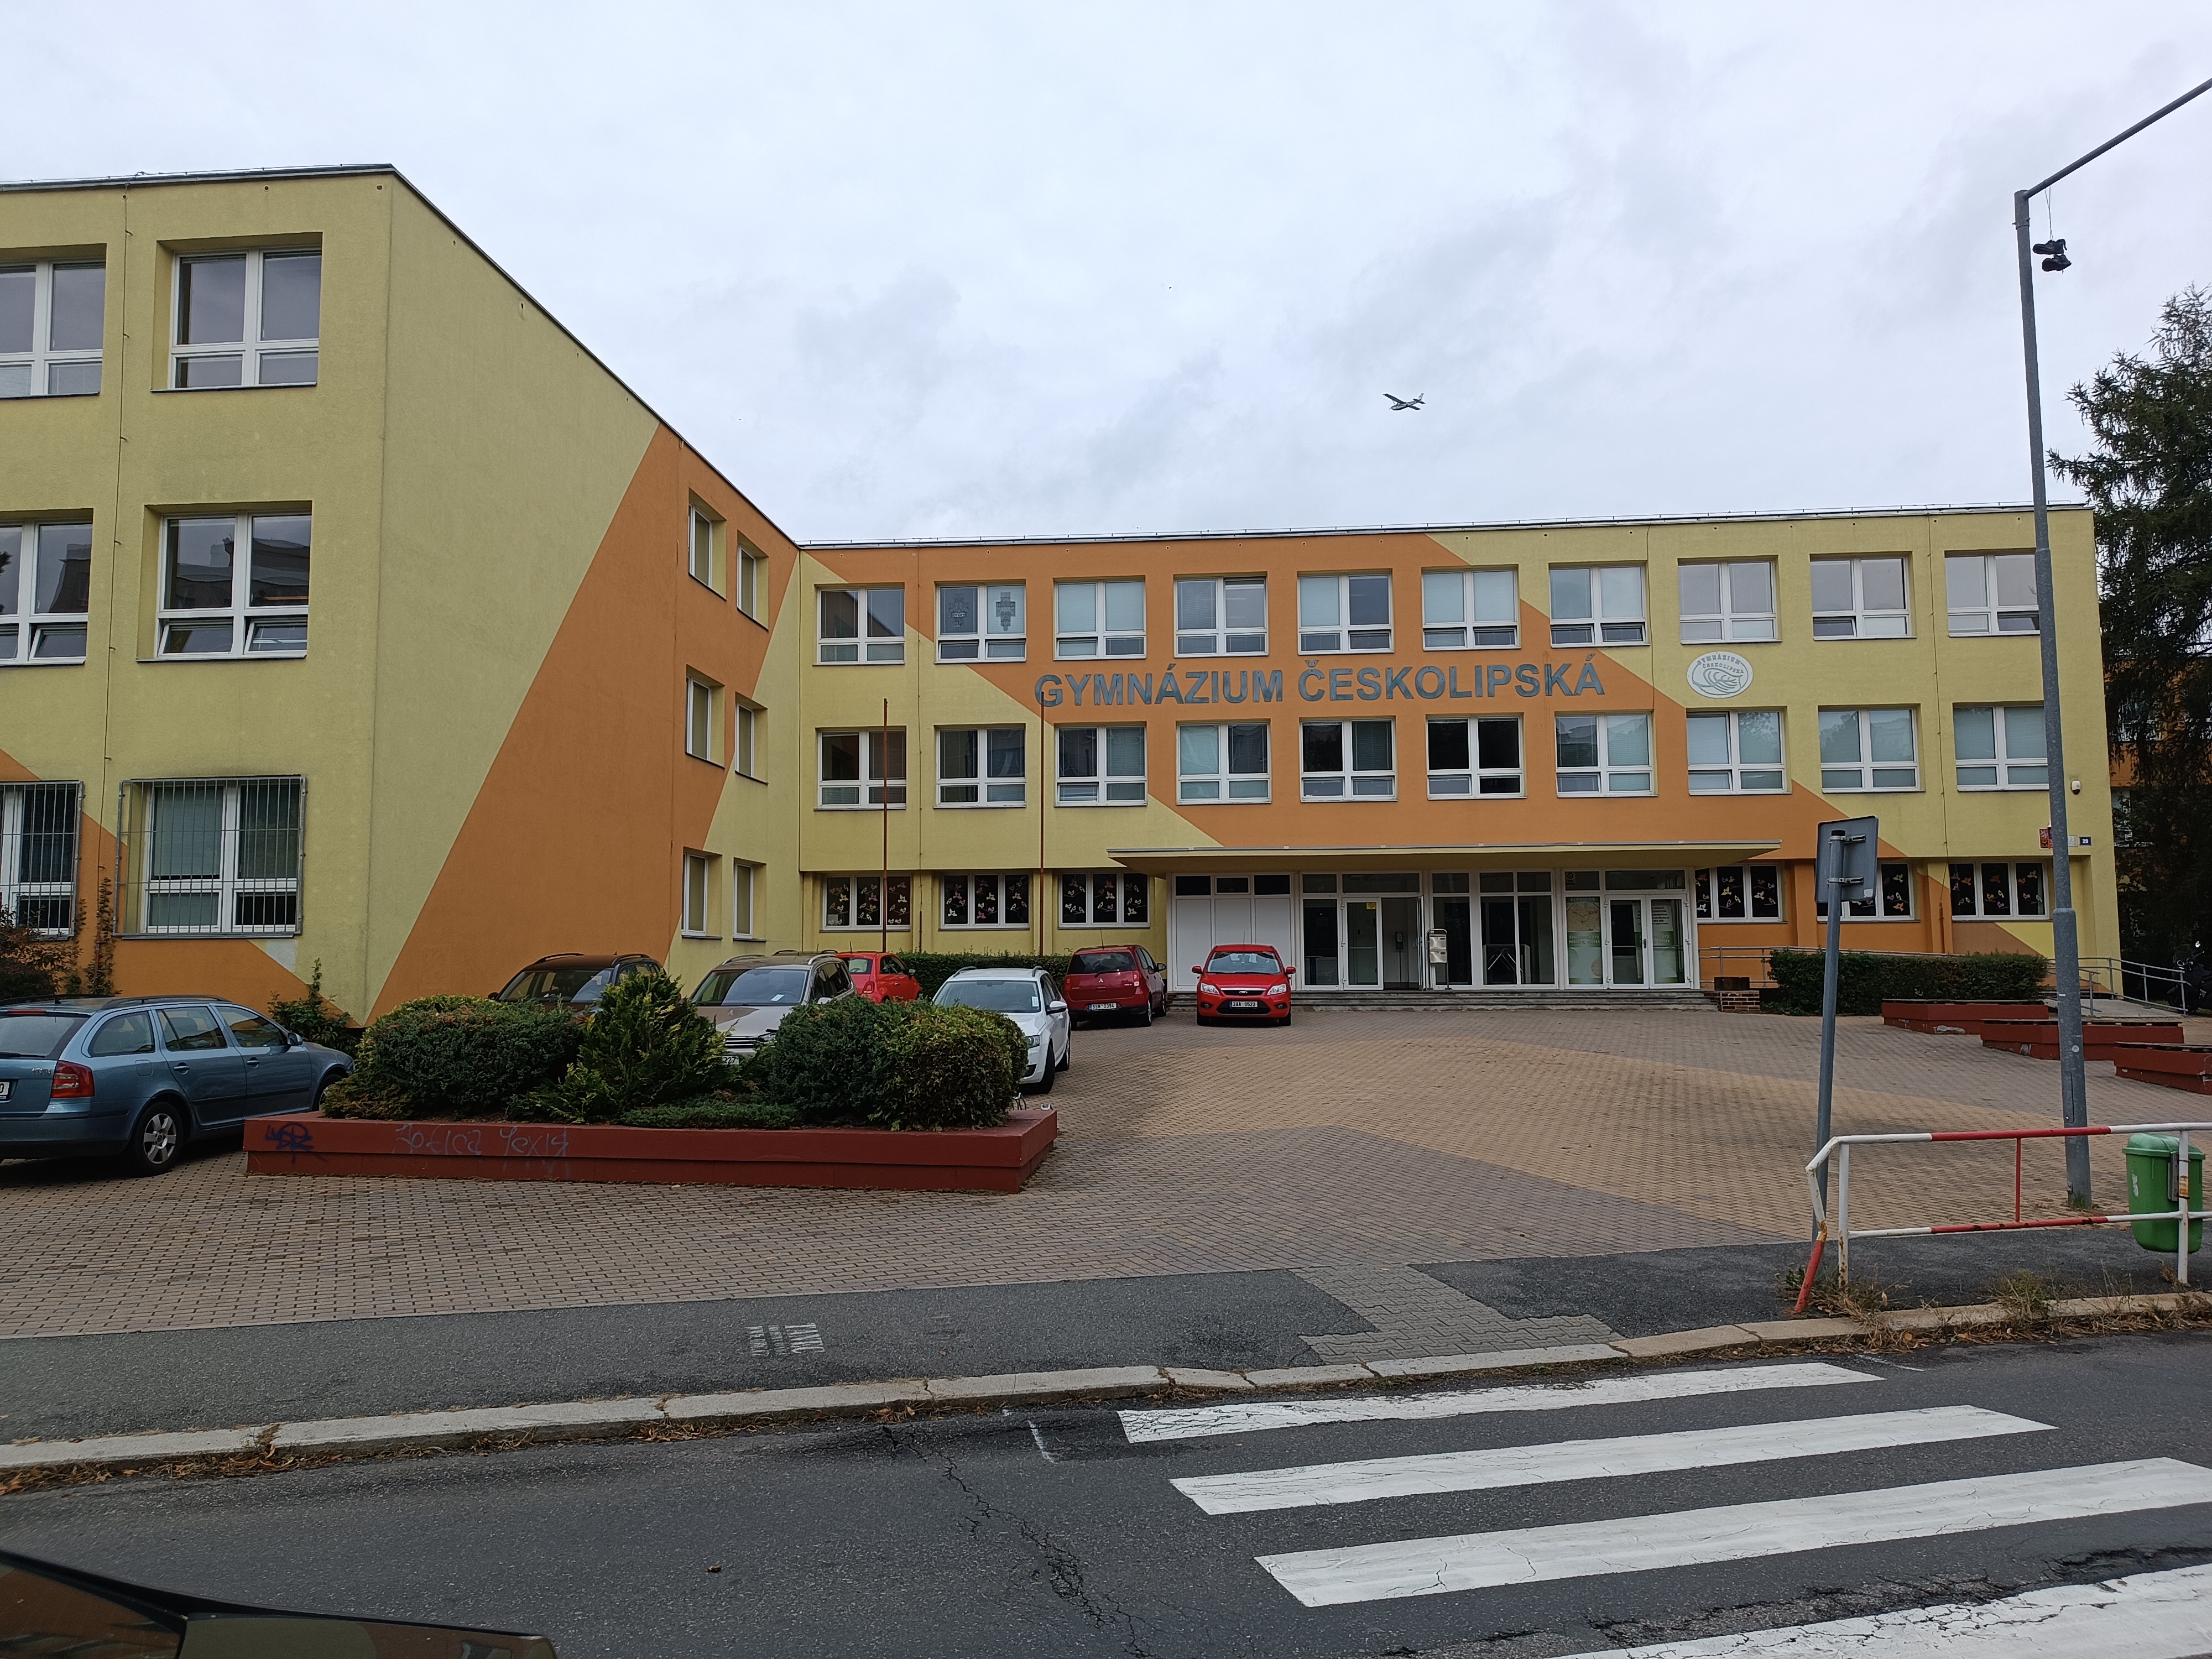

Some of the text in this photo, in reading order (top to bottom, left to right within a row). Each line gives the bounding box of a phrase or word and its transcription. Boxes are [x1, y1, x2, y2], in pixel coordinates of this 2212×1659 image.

[1697, 654, 1741, 665] GYMNÁZIUM
[1035, 653, 1605, 707] GYMNÁZIUM ČESKOLIPSKÁ
